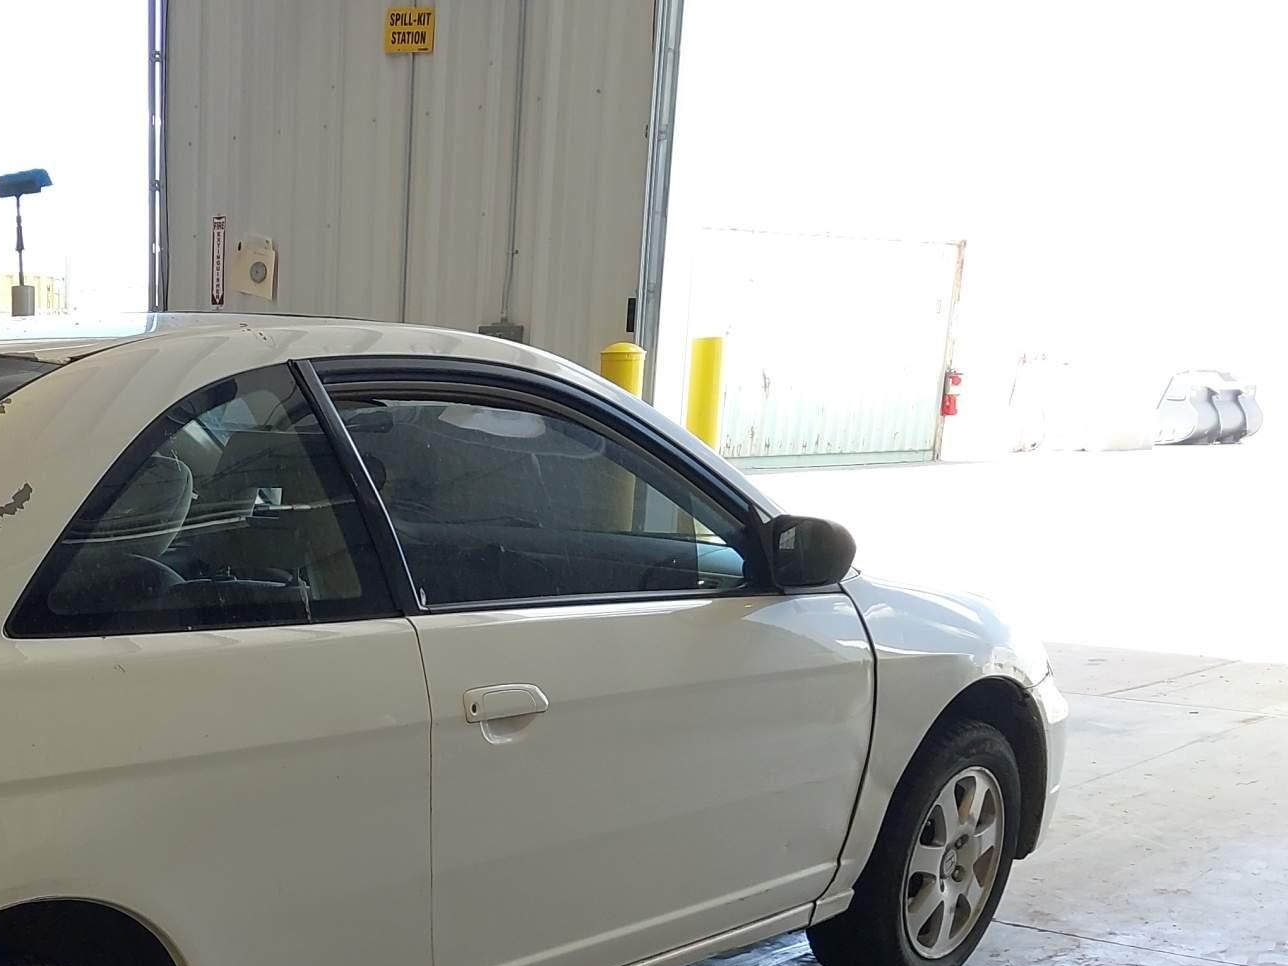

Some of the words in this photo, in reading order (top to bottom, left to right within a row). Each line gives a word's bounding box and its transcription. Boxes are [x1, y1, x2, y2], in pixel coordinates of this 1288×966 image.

[390, 12, 432, 26] SPILL-KIT
[391, 31, 426, 44] STATION
[214, 221, 225, 231] FIRE
